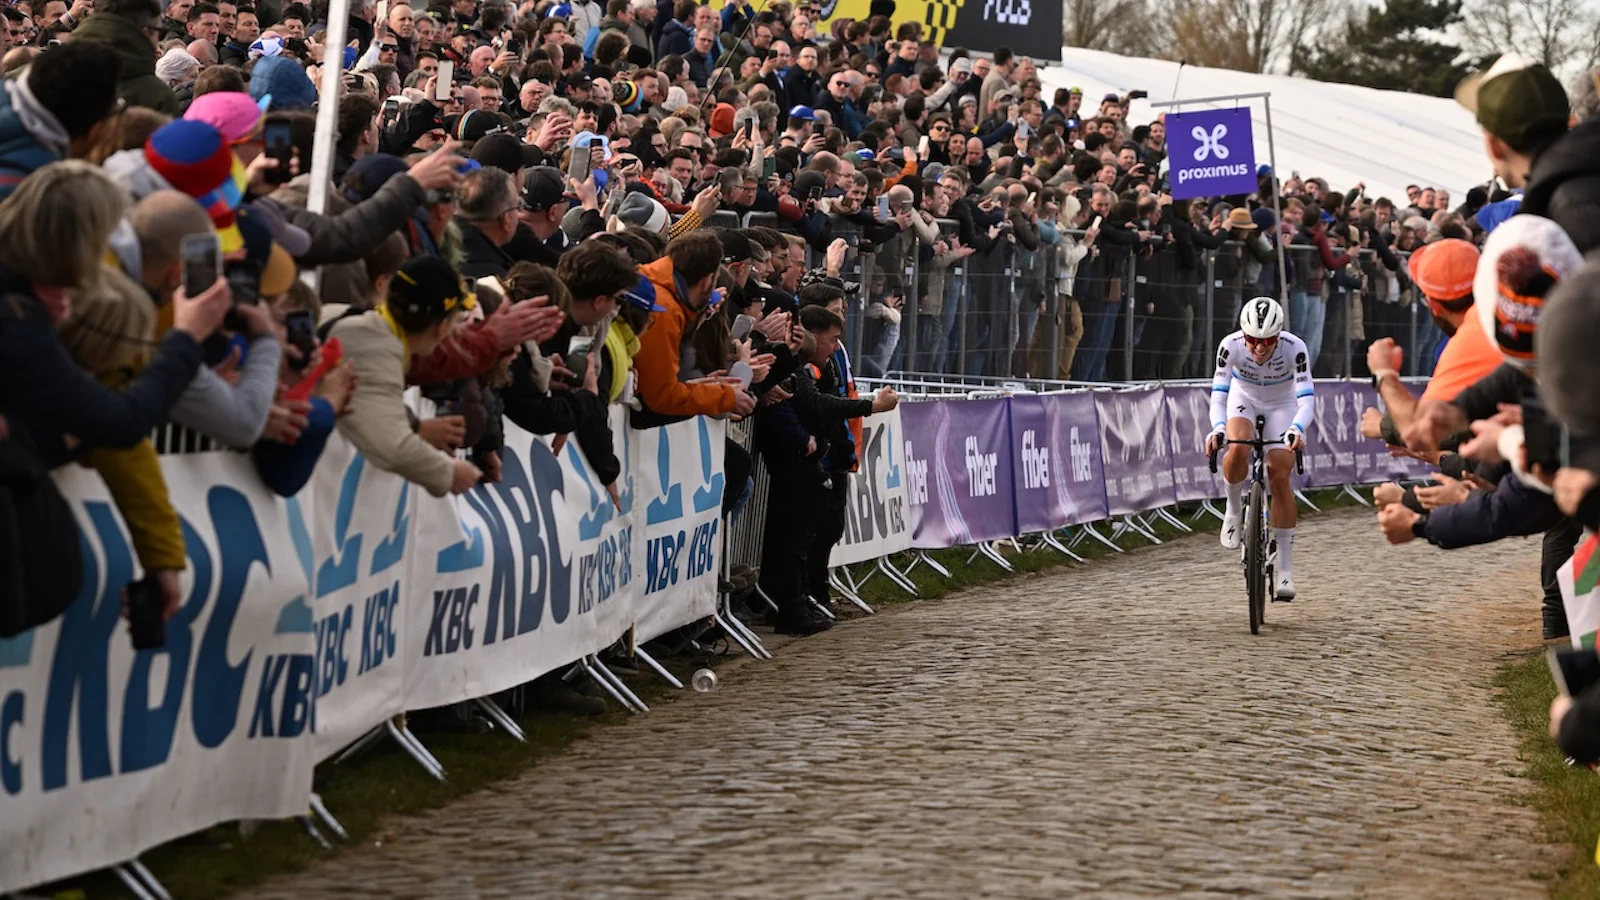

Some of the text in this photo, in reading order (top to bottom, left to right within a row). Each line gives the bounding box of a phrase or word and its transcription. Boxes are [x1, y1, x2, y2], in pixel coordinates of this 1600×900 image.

[1178, 164, 1248, 184] proximus
[965, 436, 997, 497] fiber
[1070, 426, 1091, 482] fiber
[687, 518, 718, 580] KBC
[358, 580, 399, 676] KBC
[424, 583, 480, 657] KBC
